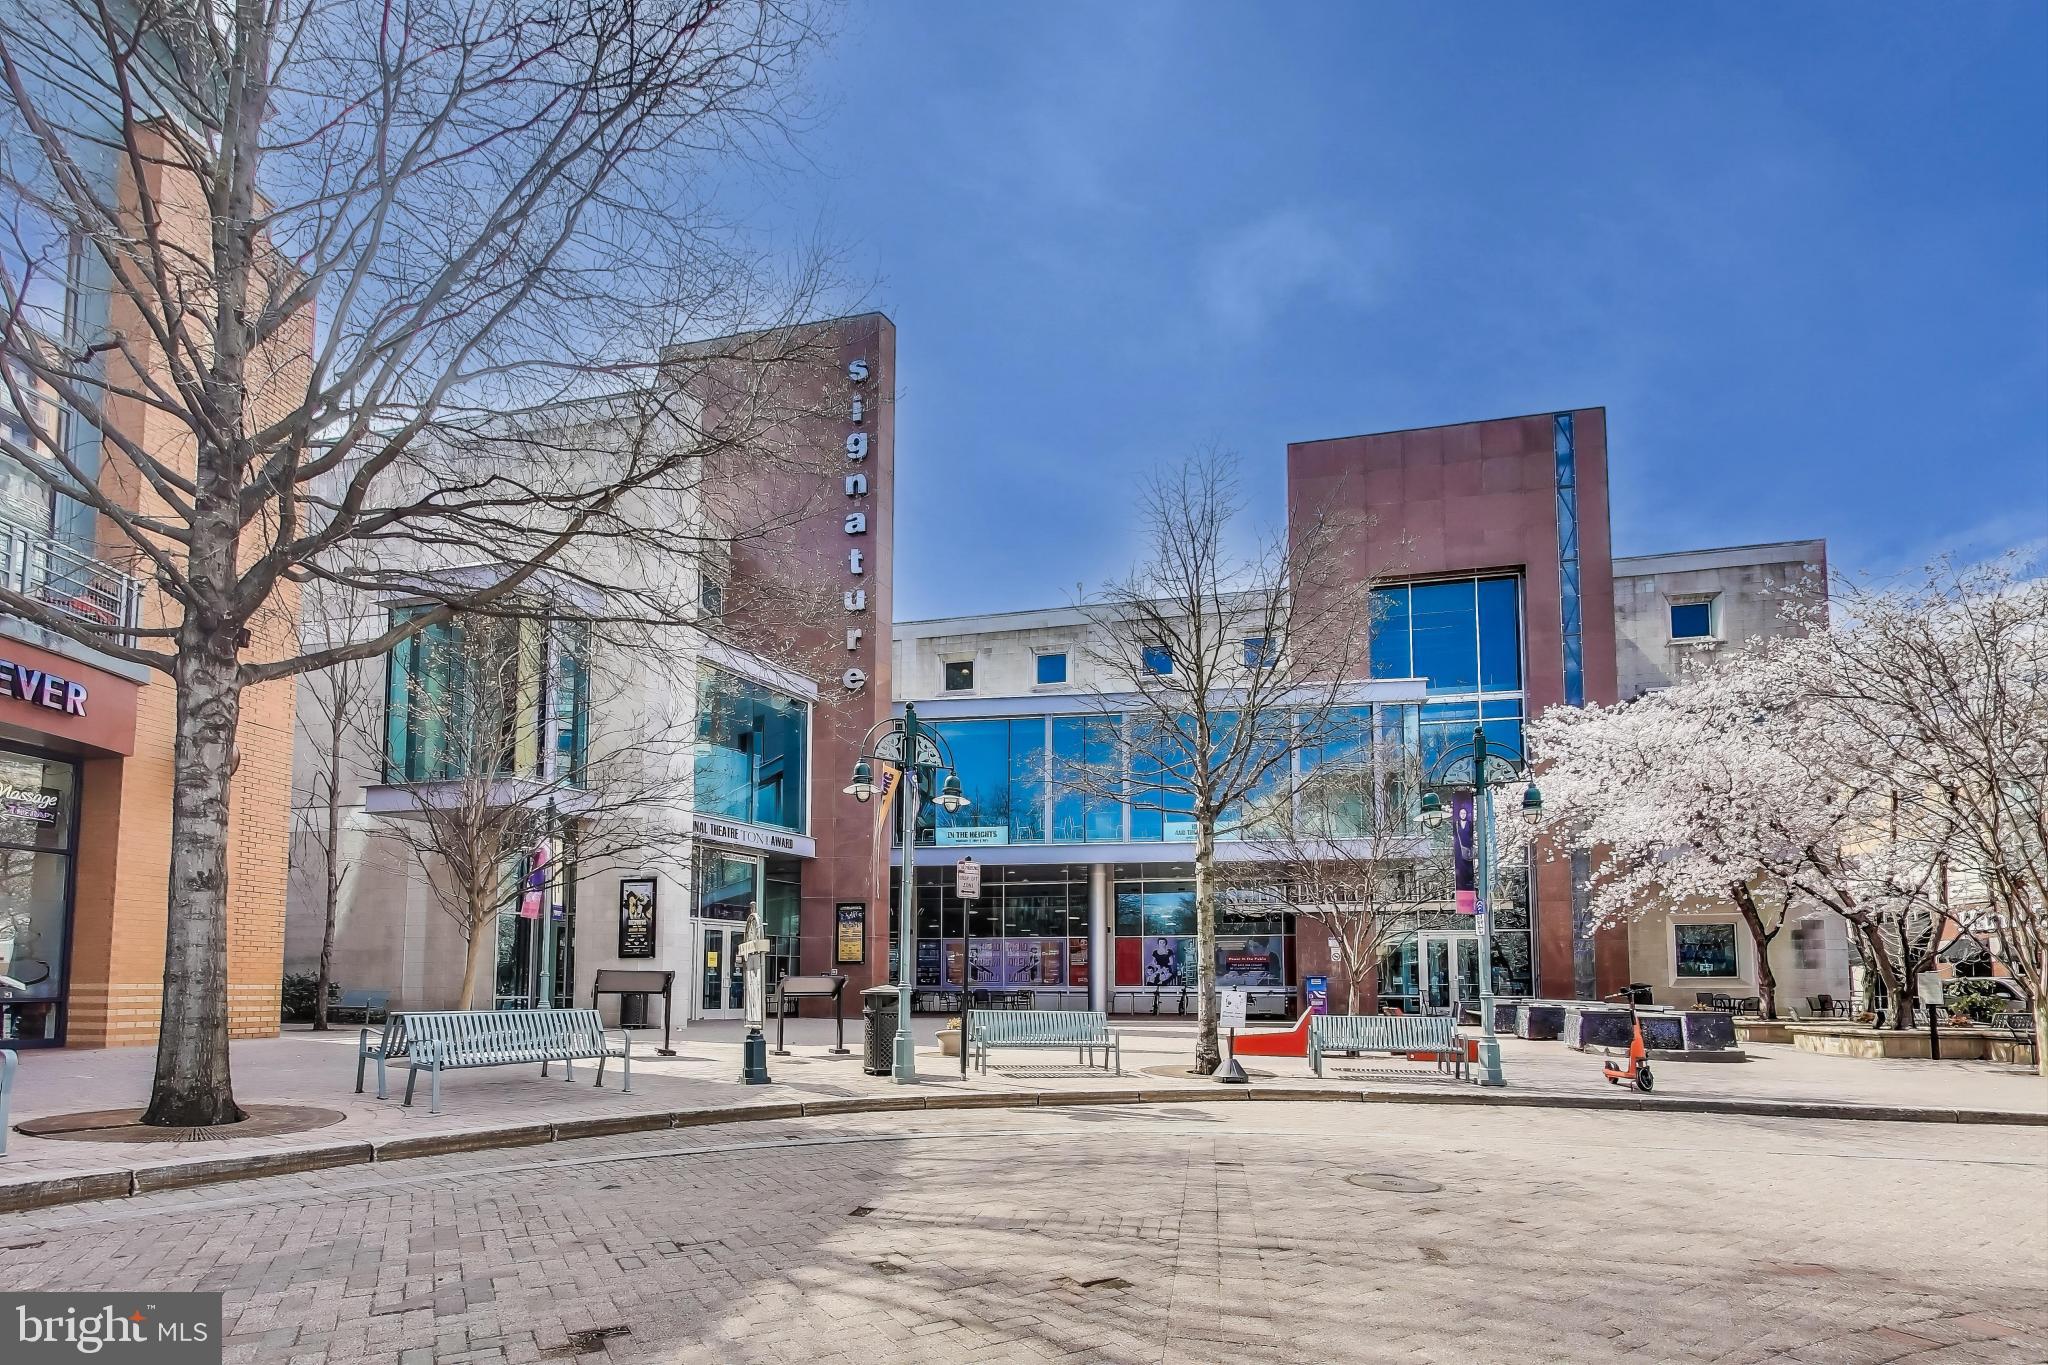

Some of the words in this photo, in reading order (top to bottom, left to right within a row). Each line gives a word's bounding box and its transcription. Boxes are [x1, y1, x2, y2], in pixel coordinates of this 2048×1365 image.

[842, 357, 870, 690] signature
[710, 823, 739, 840] THEATRE
[770, 835, 794, 850] AWARD
[956, 831, 969, 839] THE
[969, 830, 998, 839] HEIGHTS
